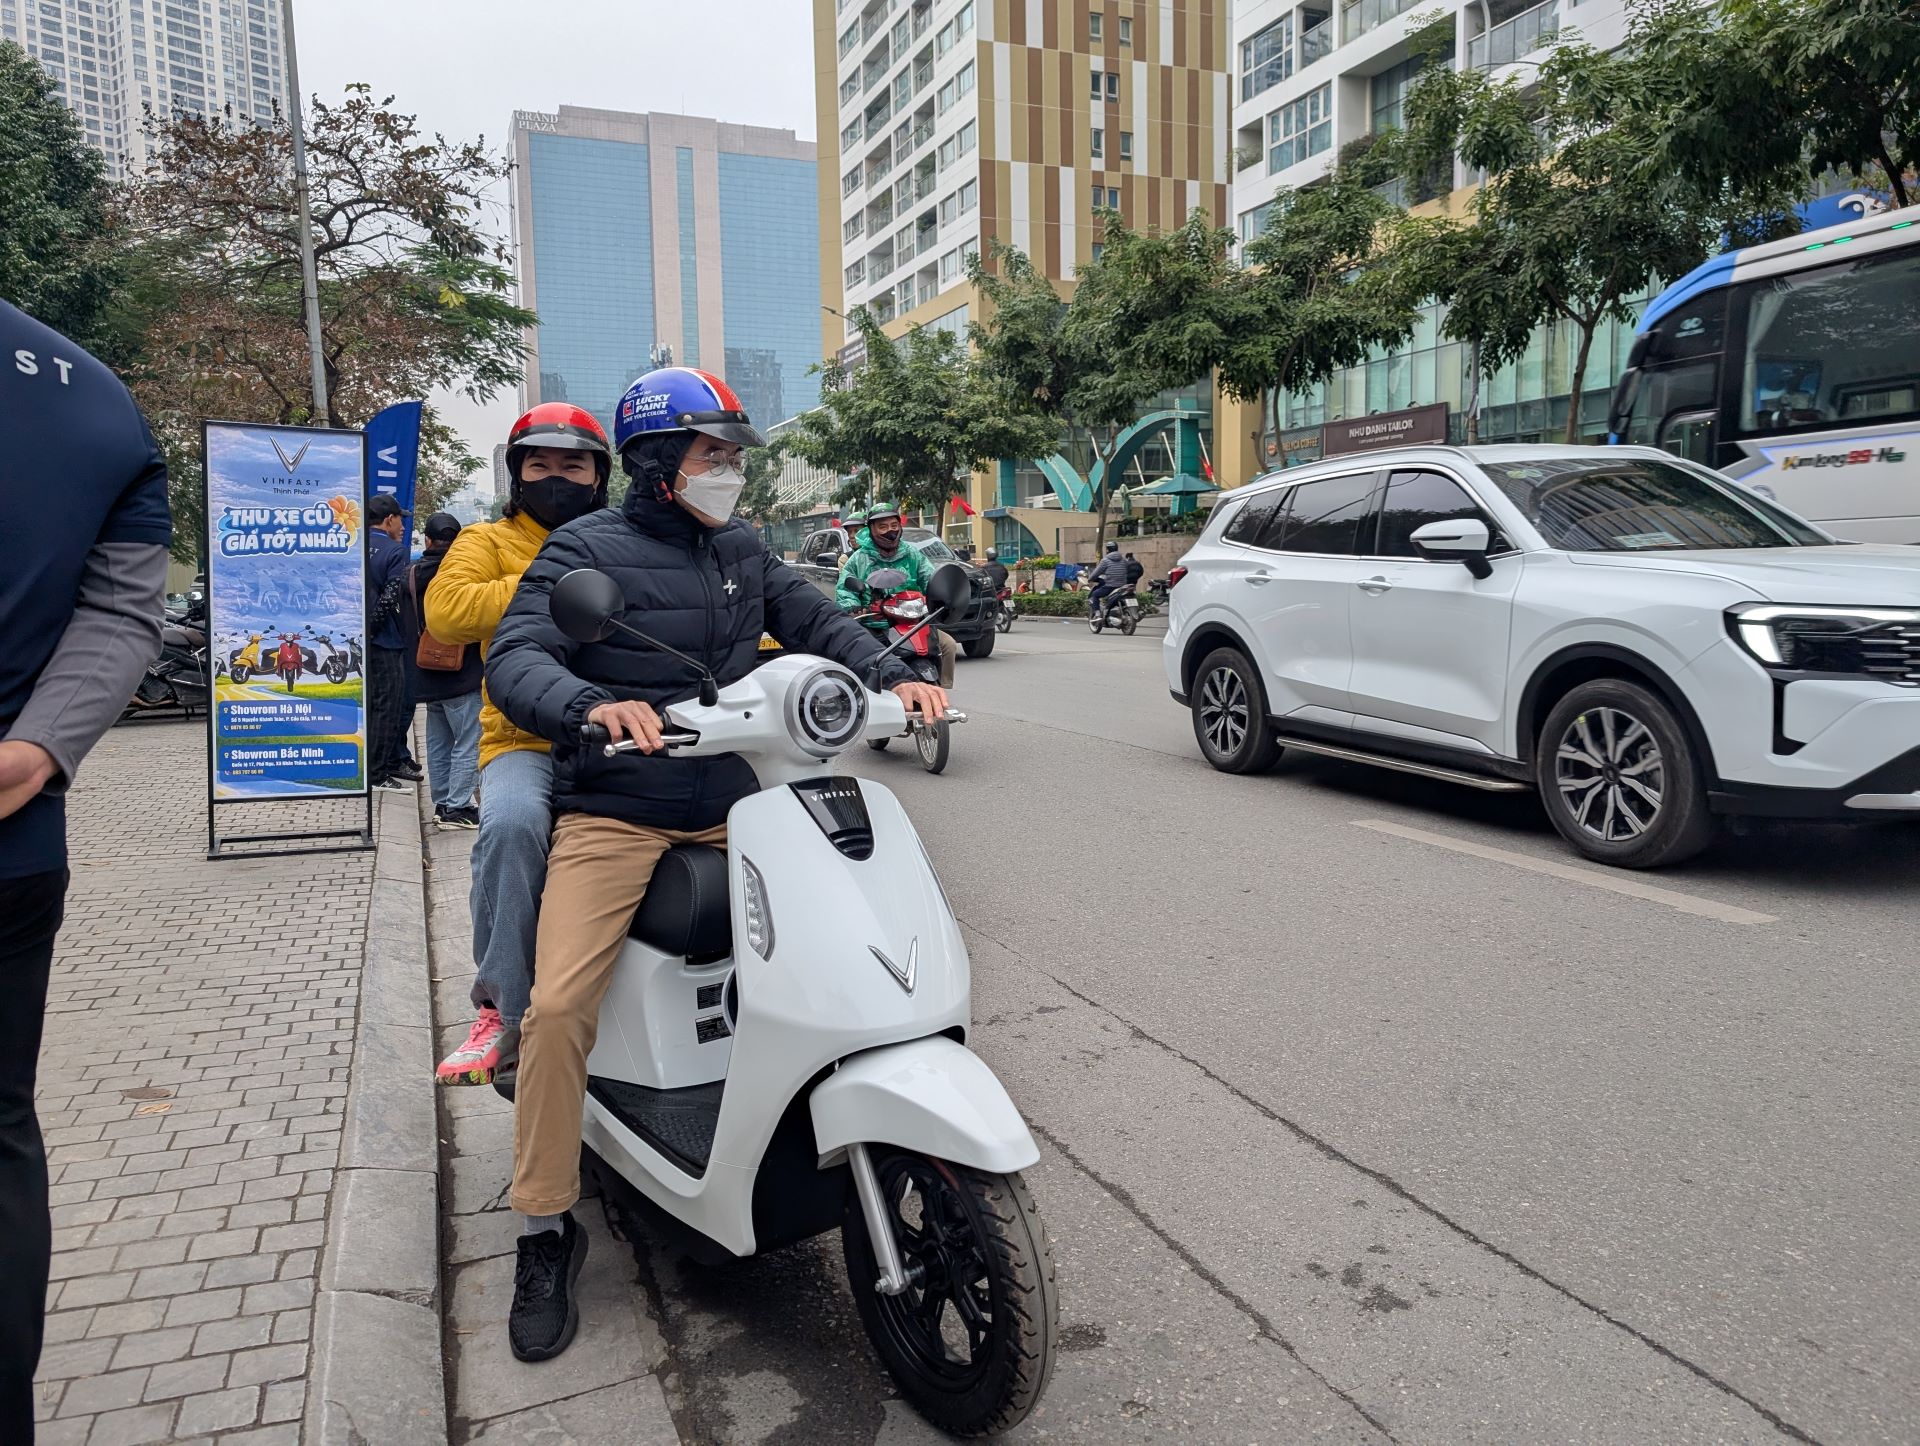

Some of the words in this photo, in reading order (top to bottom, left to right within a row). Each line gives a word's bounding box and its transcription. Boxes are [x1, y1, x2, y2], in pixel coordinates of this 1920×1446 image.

[516, 111, 558, 123] GRAND
[519, 120, 556, 132] PLAZA
[636, 394, 670, 405] LUCKY
[636, 402, 668, 413] PAINT
[1365, 424, 1387, 436] DANH
[1388, 420, 1414, 432] TAILOR
[262, 477, 320, 486] VINFAST
[230, 508, 270, 526] THU
[273, 509, 300, 525] XE
[226, 528, 259, 550] GIÁ
[262, 527, 297, 550] TỐT
[300, 522, 348, 549] NHẤT
[230, 705, 277, 715] Showrom
[280, 704, 292, 714] Hà
[295, 704, 312, 714] Nội
[231, 750, 277, 760] Showrom
[281, 746, 298, 758] Bắc
[302, 748, 324, 757] Ninh
[811, 790, 857, 802] VINFAST
